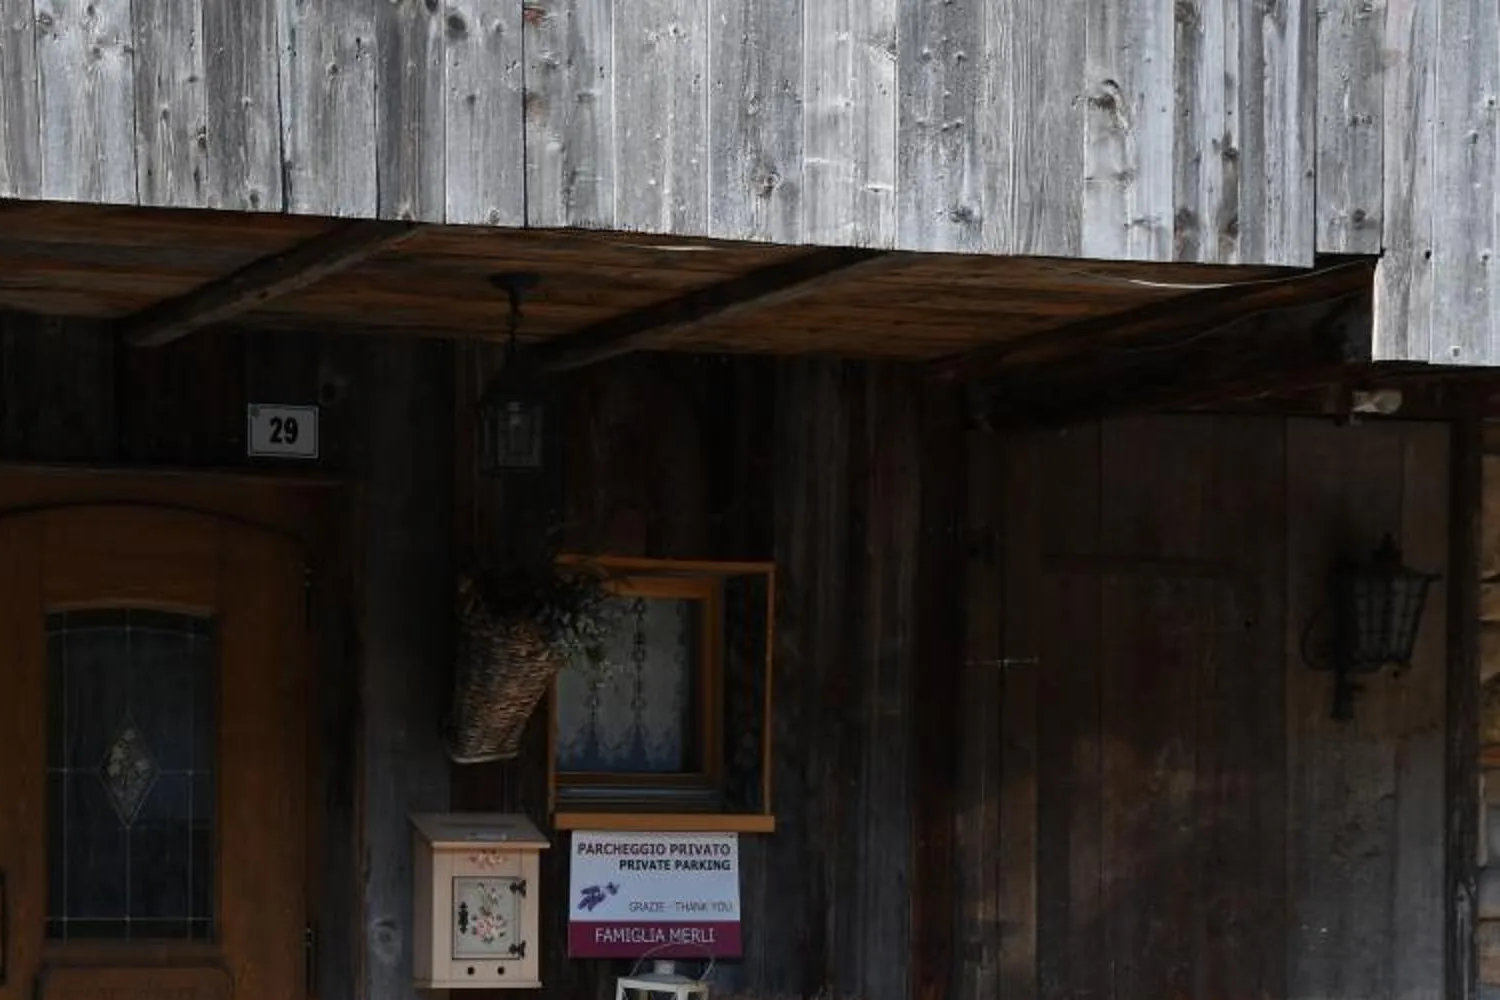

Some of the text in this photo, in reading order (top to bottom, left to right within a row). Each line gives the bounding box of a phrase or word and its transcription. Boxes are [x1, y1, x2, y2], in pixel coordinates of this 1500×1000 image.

[269, 416, 298, 444] 29
[577, 842, 731, 856] PARCHEGGIO PRIVATO
[619, 859, 731, 871] PRIVATE PARKING
[629, 902, 665, 913] GRAZIE
[675, 901, 709, 912] THANK
[595, 927, 716, 943] FAMIGLIA MERLI
